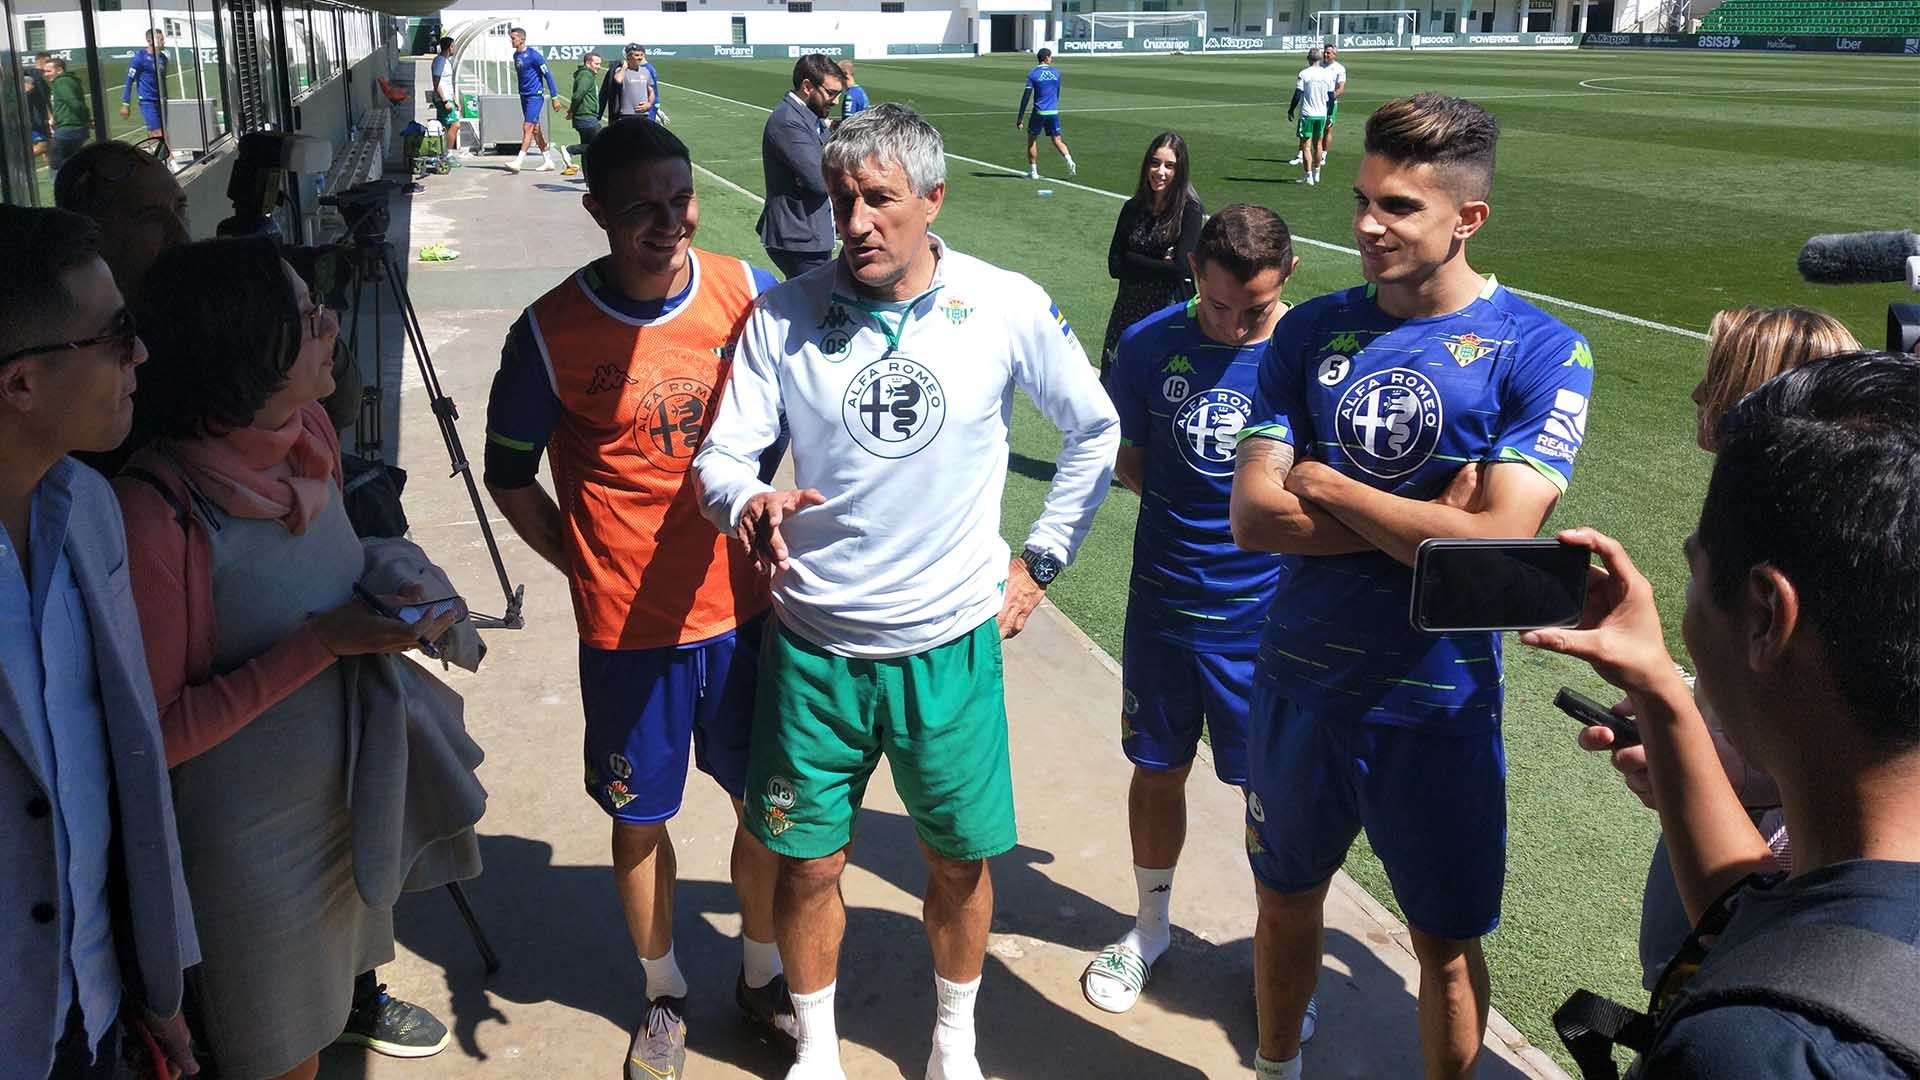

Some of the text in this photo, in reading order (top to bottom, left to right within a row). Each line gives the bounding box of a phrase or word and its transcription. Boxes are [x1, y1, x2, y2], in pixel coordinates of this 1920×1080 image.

[1064, 40, 1124, 50] POWERADE
[1143, 39, 1190, 50] Cruzcampo
[1220, 36, 1263, 49] Kappa
[1295, 35, 1324, 43] REALE
[1355, 35, 1395, 47] CaixaBank
[1469, 35, 1520, 44] POWERADE
[1535, 34, 1574, 45] Cruzcampo
[1697, 35, 1731, 48] asisa
[1836, 38, 1861, 49] Uber
[547, 45, 595, 60] ASPY
[714, 45, 754, 56] Fontarel
[1327, 359, 1343, 381] 5
[848, 362, 941, 409] ALFA ROMEO
[1166, 379, 1186, 399] 18
[1341, 372, 1437, 427] ALFA ROMEO
[639, 391, 662, 433] ALFA
[1177, 392, 1253, 430] ALFA ROM
